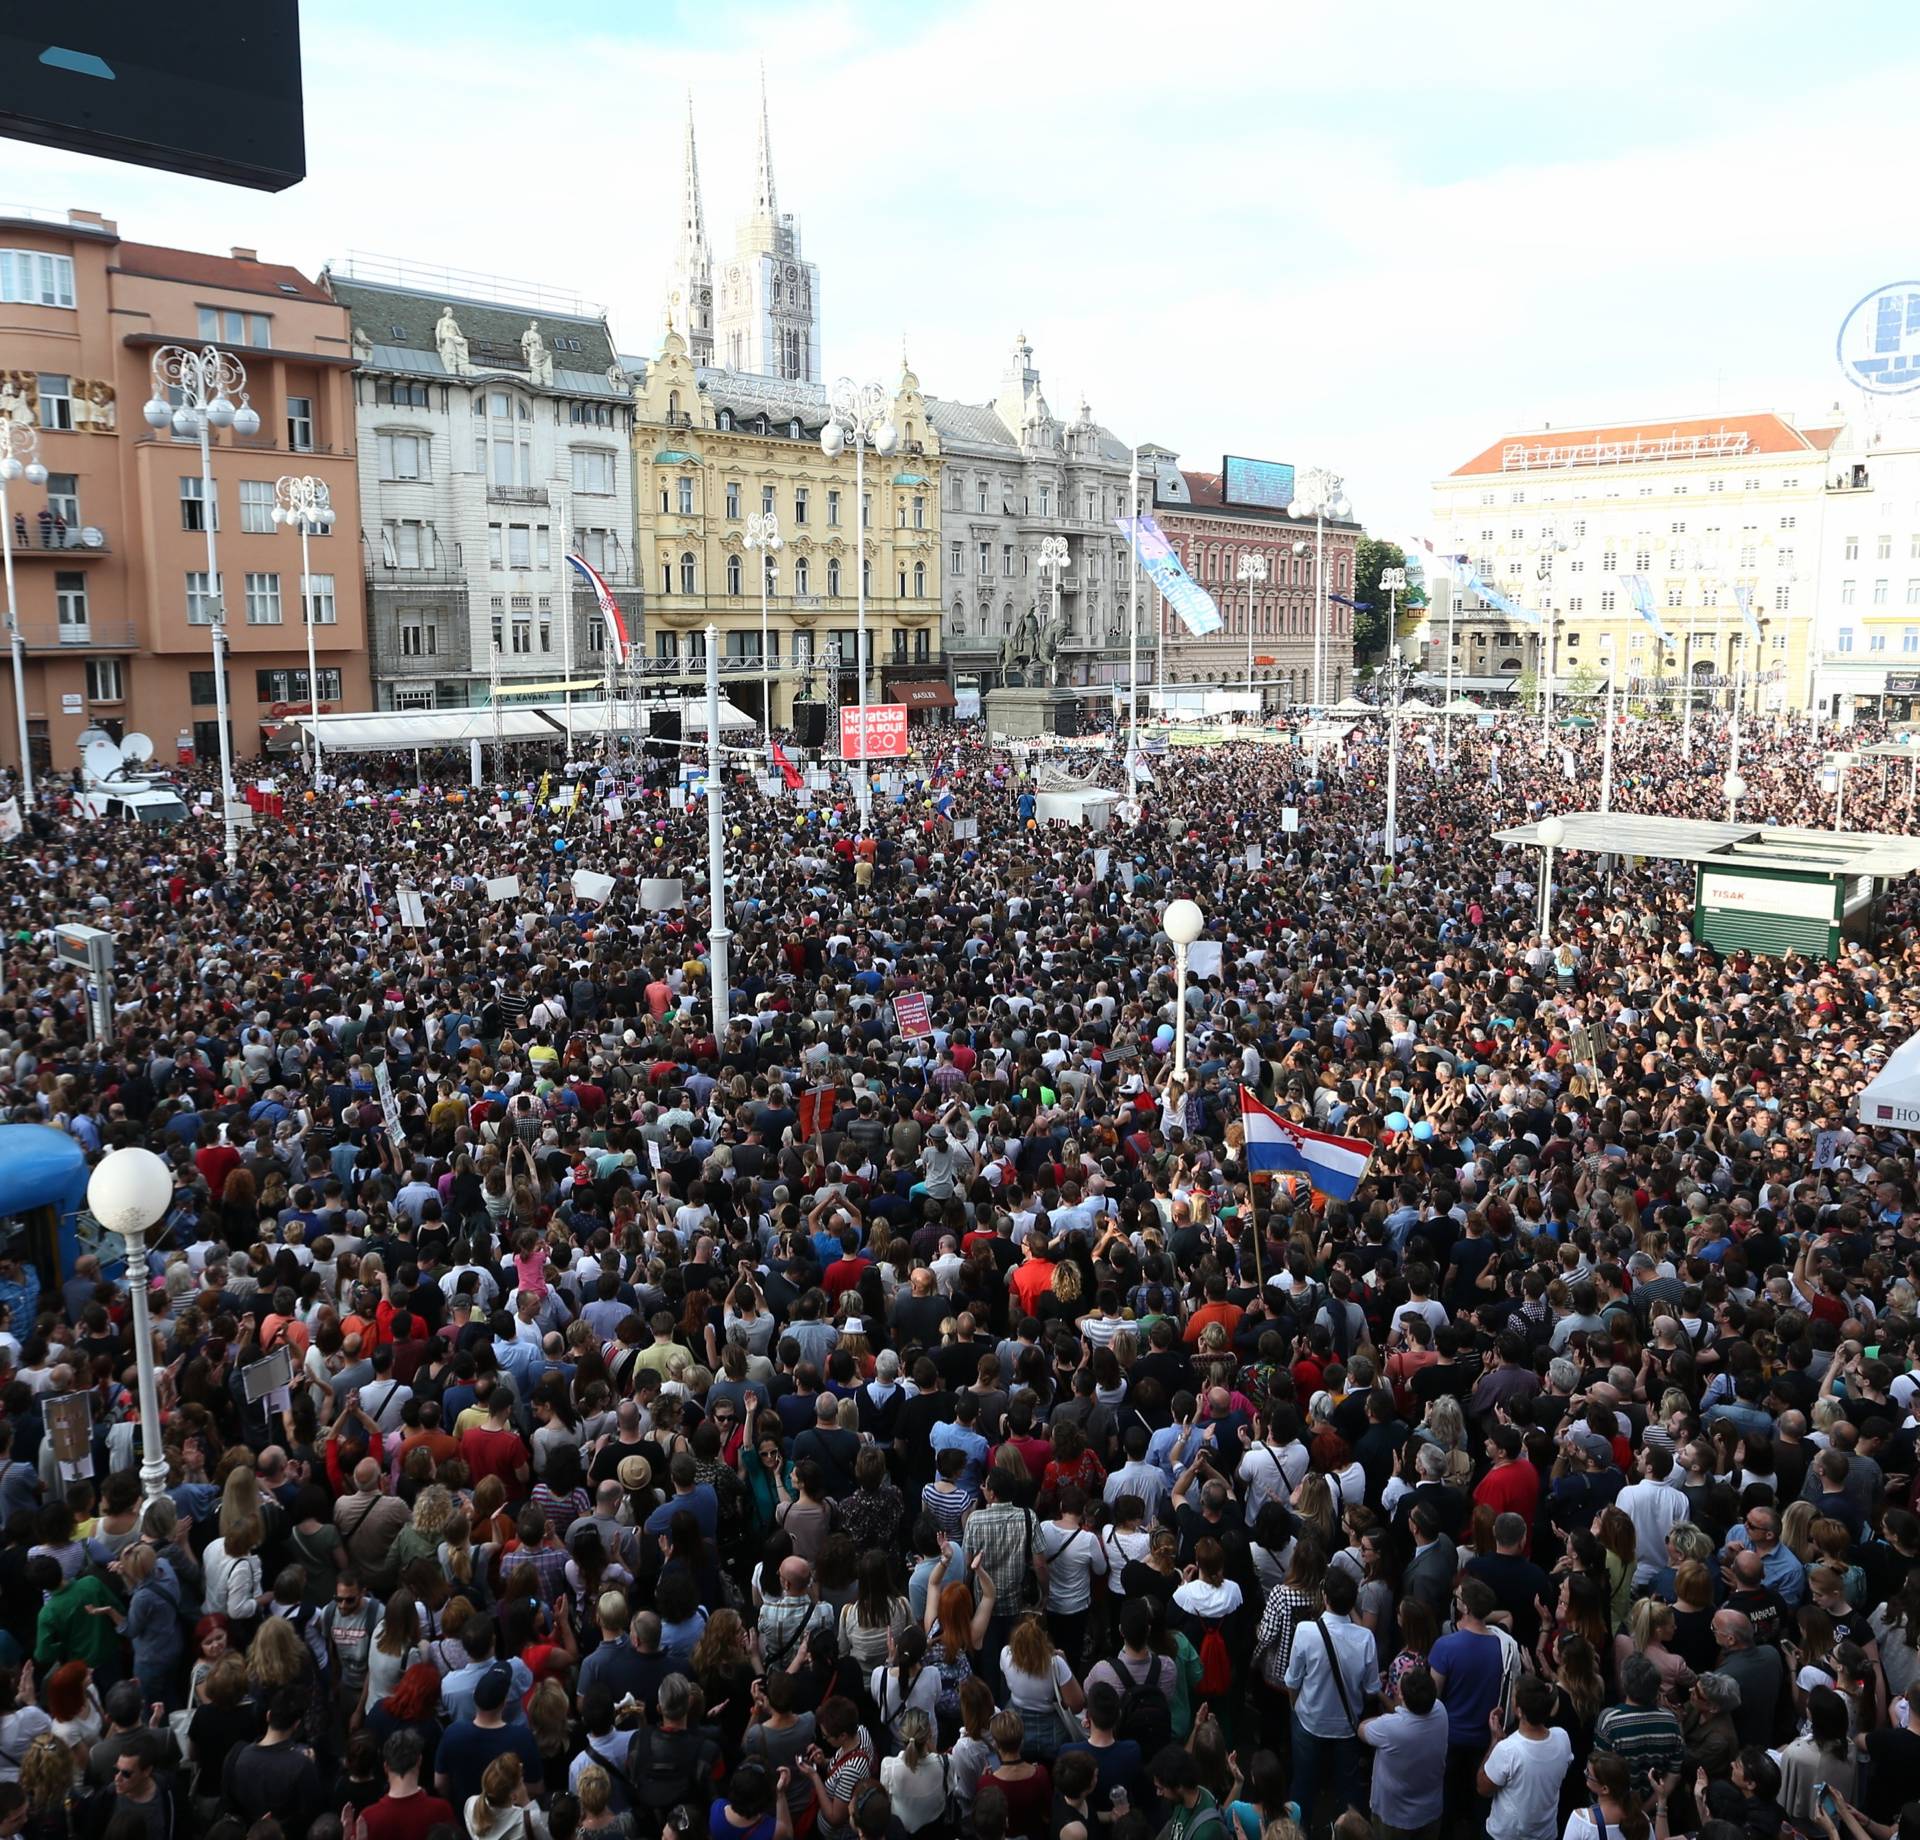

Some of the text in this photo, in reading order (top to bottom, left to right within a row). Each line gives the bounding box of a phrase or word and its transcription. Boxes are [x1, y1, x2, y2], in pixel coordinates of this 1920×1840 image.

[912, 690, 937, 700] BASLER
[876, 722, 905, 734] BOLJE
[1711, 888, 1746, 901] TISAK
